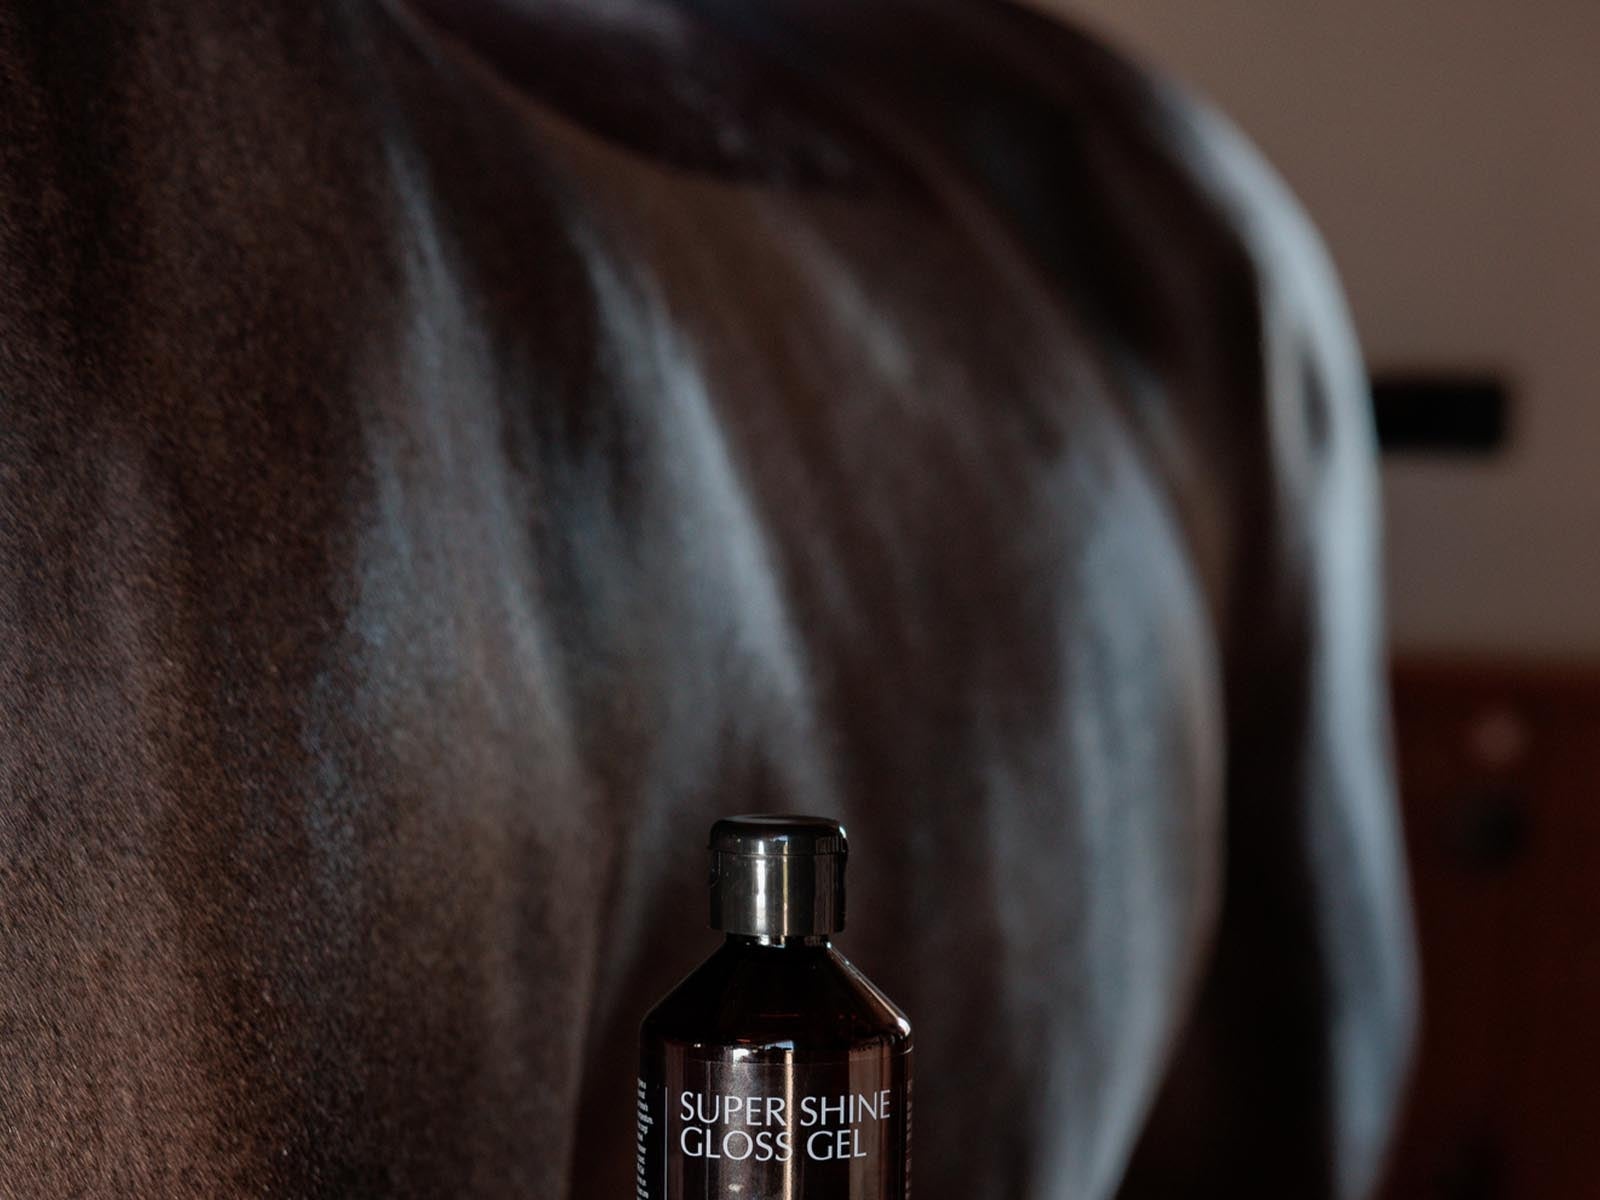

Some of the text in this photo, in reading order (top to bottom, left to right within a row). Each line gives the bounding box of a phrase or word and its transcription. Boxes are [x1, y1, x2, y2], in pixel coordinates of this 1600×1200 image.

[680, 1089, 891, 1127] SUPER SHINE
[680, 1126, 867, 1162] GLOSS GEL
